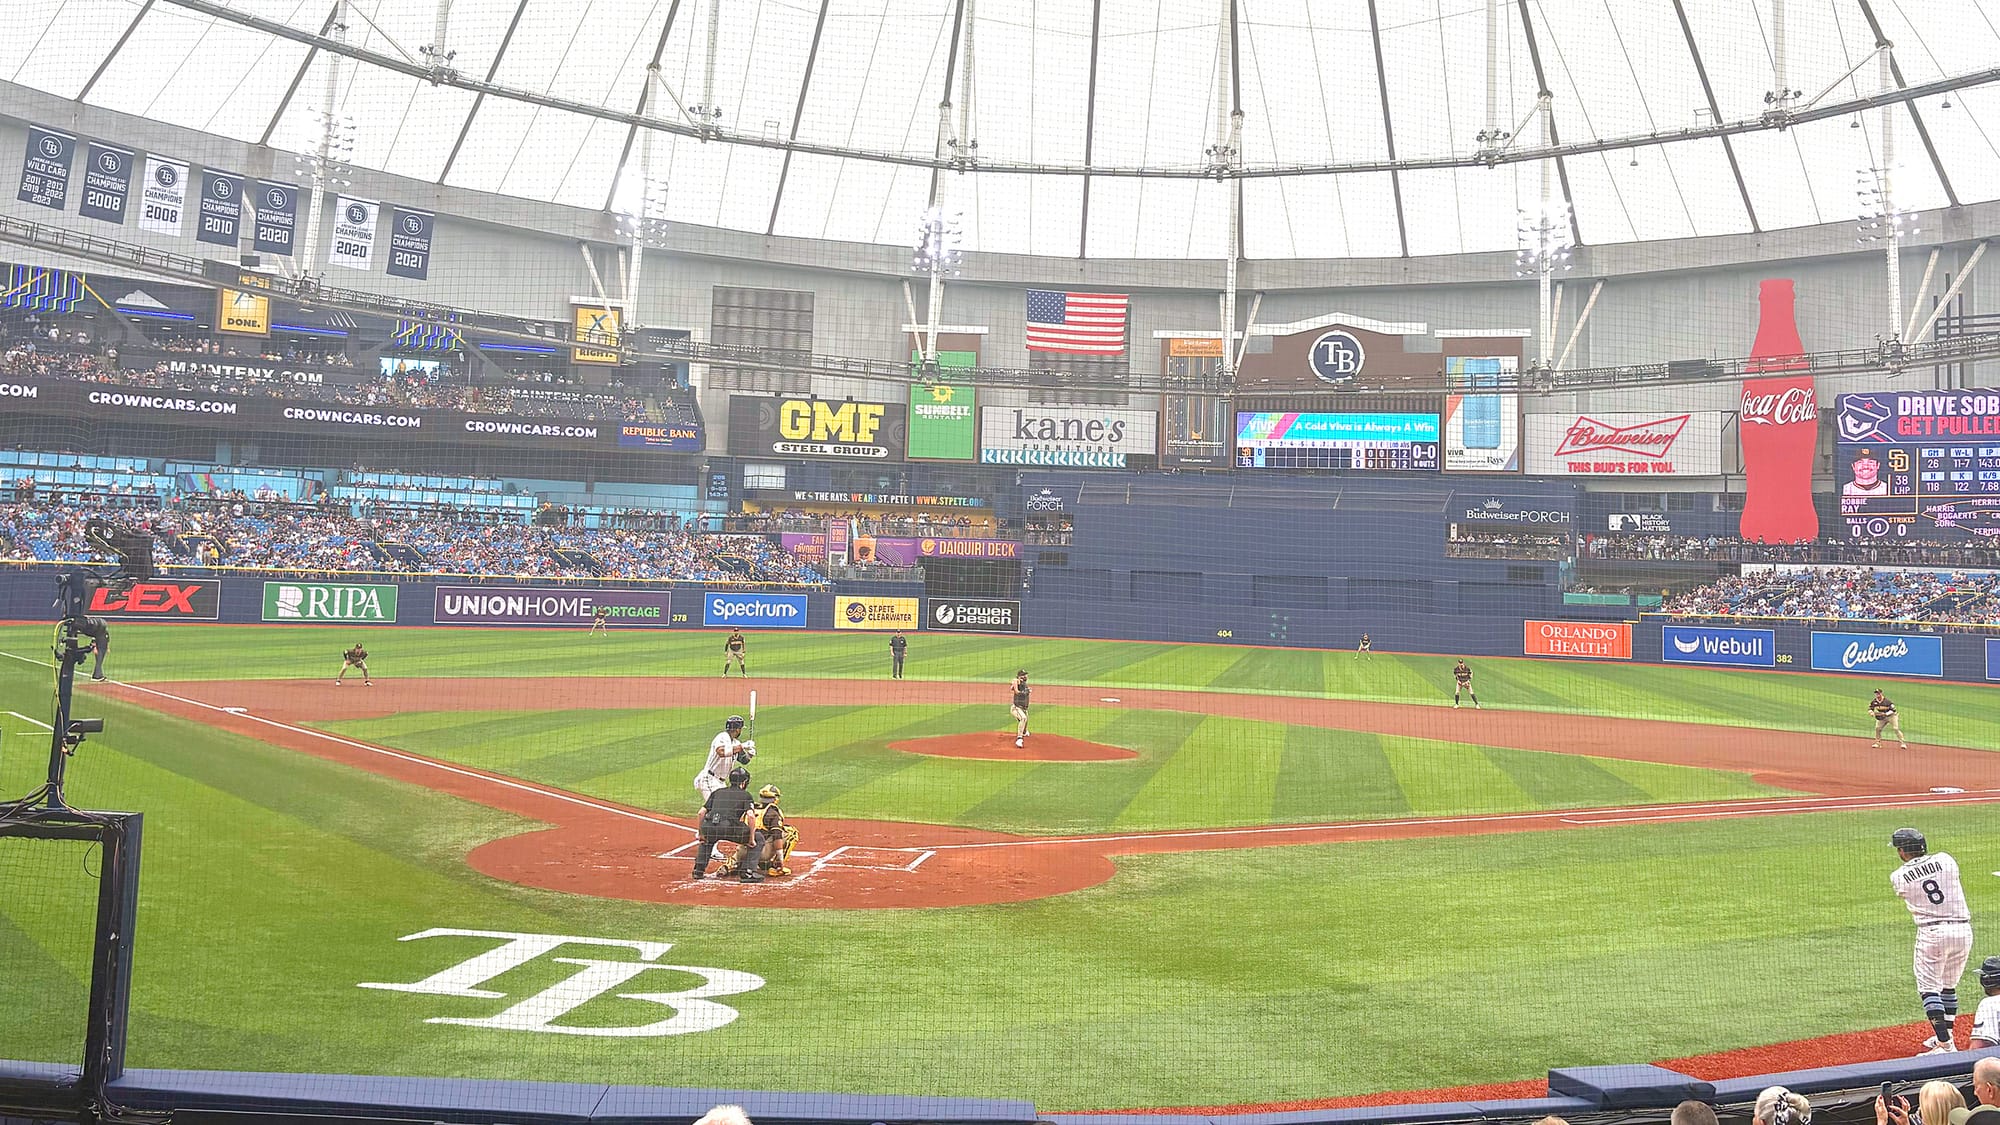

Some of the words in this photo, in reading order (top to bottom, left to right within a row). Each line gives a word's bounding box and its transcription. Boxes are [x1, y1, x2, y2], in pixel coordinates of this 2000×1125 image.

[27, 160, 46, 171] WILD
[48, 164, 67, 177] CARD
[25, 174, 41, 185] 2011
[46, 180, 64, 190] 2013
[87, 175, 127, 192] CHAMPIONS
[22, 182, 39, 193] 2019
[45, 188, 64, 200] 2022
[144, 189, 183, 205] CHAMPIONS
[32, 194, 51, 206] 2023
[87, 191, 121, 211] 2008
[145, 204, 178, 223] 2008
[202, 202, 239, 216] CHAMPIONS
[205, 217, 233, 235] 2010
[257, 212, 294, 226] CHAMPIONS
[259, 226, 289, 244] 2020
[335, 226, 373, 241] CHAMPIONS
[336, 240, 367, 258] 2020
[392, 238, 429, 251] CHAMPIONS
[395, 251, 423, 269] 2021
[227, 317, 261, 328] DONE.
[1319, 341, 1356, 373] TB
[88, 391, 238, 415] CROWNCARS.COM
[1741, 387, 1817, 426] Coca-Cola
[1897, 396, 1958, 416] DRIVE
[283, 406, 421, 428] CROWNCARS.COM
[779, 399, 885, 443] GMF
[464, 419, 598, 439] CROWNCARS.COM
[622, 426, 668, 437] REPUBLIC
[669, 428, 697, 439] BANK
[1012, 409, 1127, 443] kane's
[1305, 421, 1327, 431] Cold
[1329, 421, 1352, 431] Viva
[1365, 422, 1402, 434] Always
[1413, 422, 1435, 432] Win
[1897, 416, 1934, 435] GET
[1567, 426, 1677, 447] Budweiser
[781, 443, 828, 454] STEEL
[833, 445, 881, 456] GROUP
[1022, 443, 1115, 452] FURNITURE
[1257, 448, 1263, 456] 0
[1367, 449, 1374, 458] 0
[1391, 449, 1397, 458] 2
[1402, 449, 1408, 458] 2
[1412, 444, 1436, 459] 0-0
[1927, 449, 1940, 457] GM
[1954, 449, 1969, 457] W-L
[1986, 449, 1994, 457] IP
[1367, 459, 1374, 468] 0
[1402, 460, 1408, 469] 2
[1419, 460, 1435, 468] OUTS
[1567, 462, 1591, 473] THIS
[1593, 462, 1625, 473] BUD'S
[1627, 462, 1648, 473] FOR
[1650, 462, 1676, 473] YOU.
[1927, 459, 1940, 468] 26
[1953, 459, 1970, 468] 11-7
[1978, 458, 2000, 468] 143.0
[1895, 475, 1909, 486] 38
[1982, 472, 1997, 480] K/9
[1894, 486, 1911, 495] LHP
[1926, 482, 1940, 491] 118
[1954, 482, 1969, 491] 122
[1980, 481, 1999, 491] 7.68
[795, 491, 806, 500] WE
[815, 492, 829, 501] THE
[851, 493, 863, 502] WE
[890, 495, 909, 504] PETE
[1026, 501, 1064, 511] PORCH
[1841, 504, 1860, 513] RAY
[1926, 505, 1955, 513] HARRIS
[1466, 508, 1520, 520] Budweiser
[1520, 510, 1570, 523] PORCH
[1846, 517, 1867, 525] BALLS
[1888, 516, 1916, 524] STRIKES
[1937, 512, 1978, 520] BOGAERTS
[1851, 525, 1861, 537] 0
[1874, 523, 1882, 532] 0
[1897, 524, 1907, 537] 0
[811, 535, 825, 545] FAN
[793, 544, 825, 554] FAVORITE
[939, 541, 985, 557] DAIQUIRI
[988, 543, 1016, 558] DECK
[305, 586, 385, 618] RIPA
[712, 598, 793, 621] Spectrum
[672, 614, 688, 622] 378
[868, 613, 912, 622] CLEARWATER
[1216, 629, 1233, 638] 404
[1540, 624, 1617, 640] ORLANDO
[1549, 639, 1608, 654] HEALTH
[1703, 636, 1763, 657] Webull
[1842, 638, 1909, 669] Culver's
[1776, 654, 1793, 663] 382
[1902, 860, 1943, 884] ARANDA
[1921, 879, 1945, 905] 8
[356, 927, 767, 1037] TB
